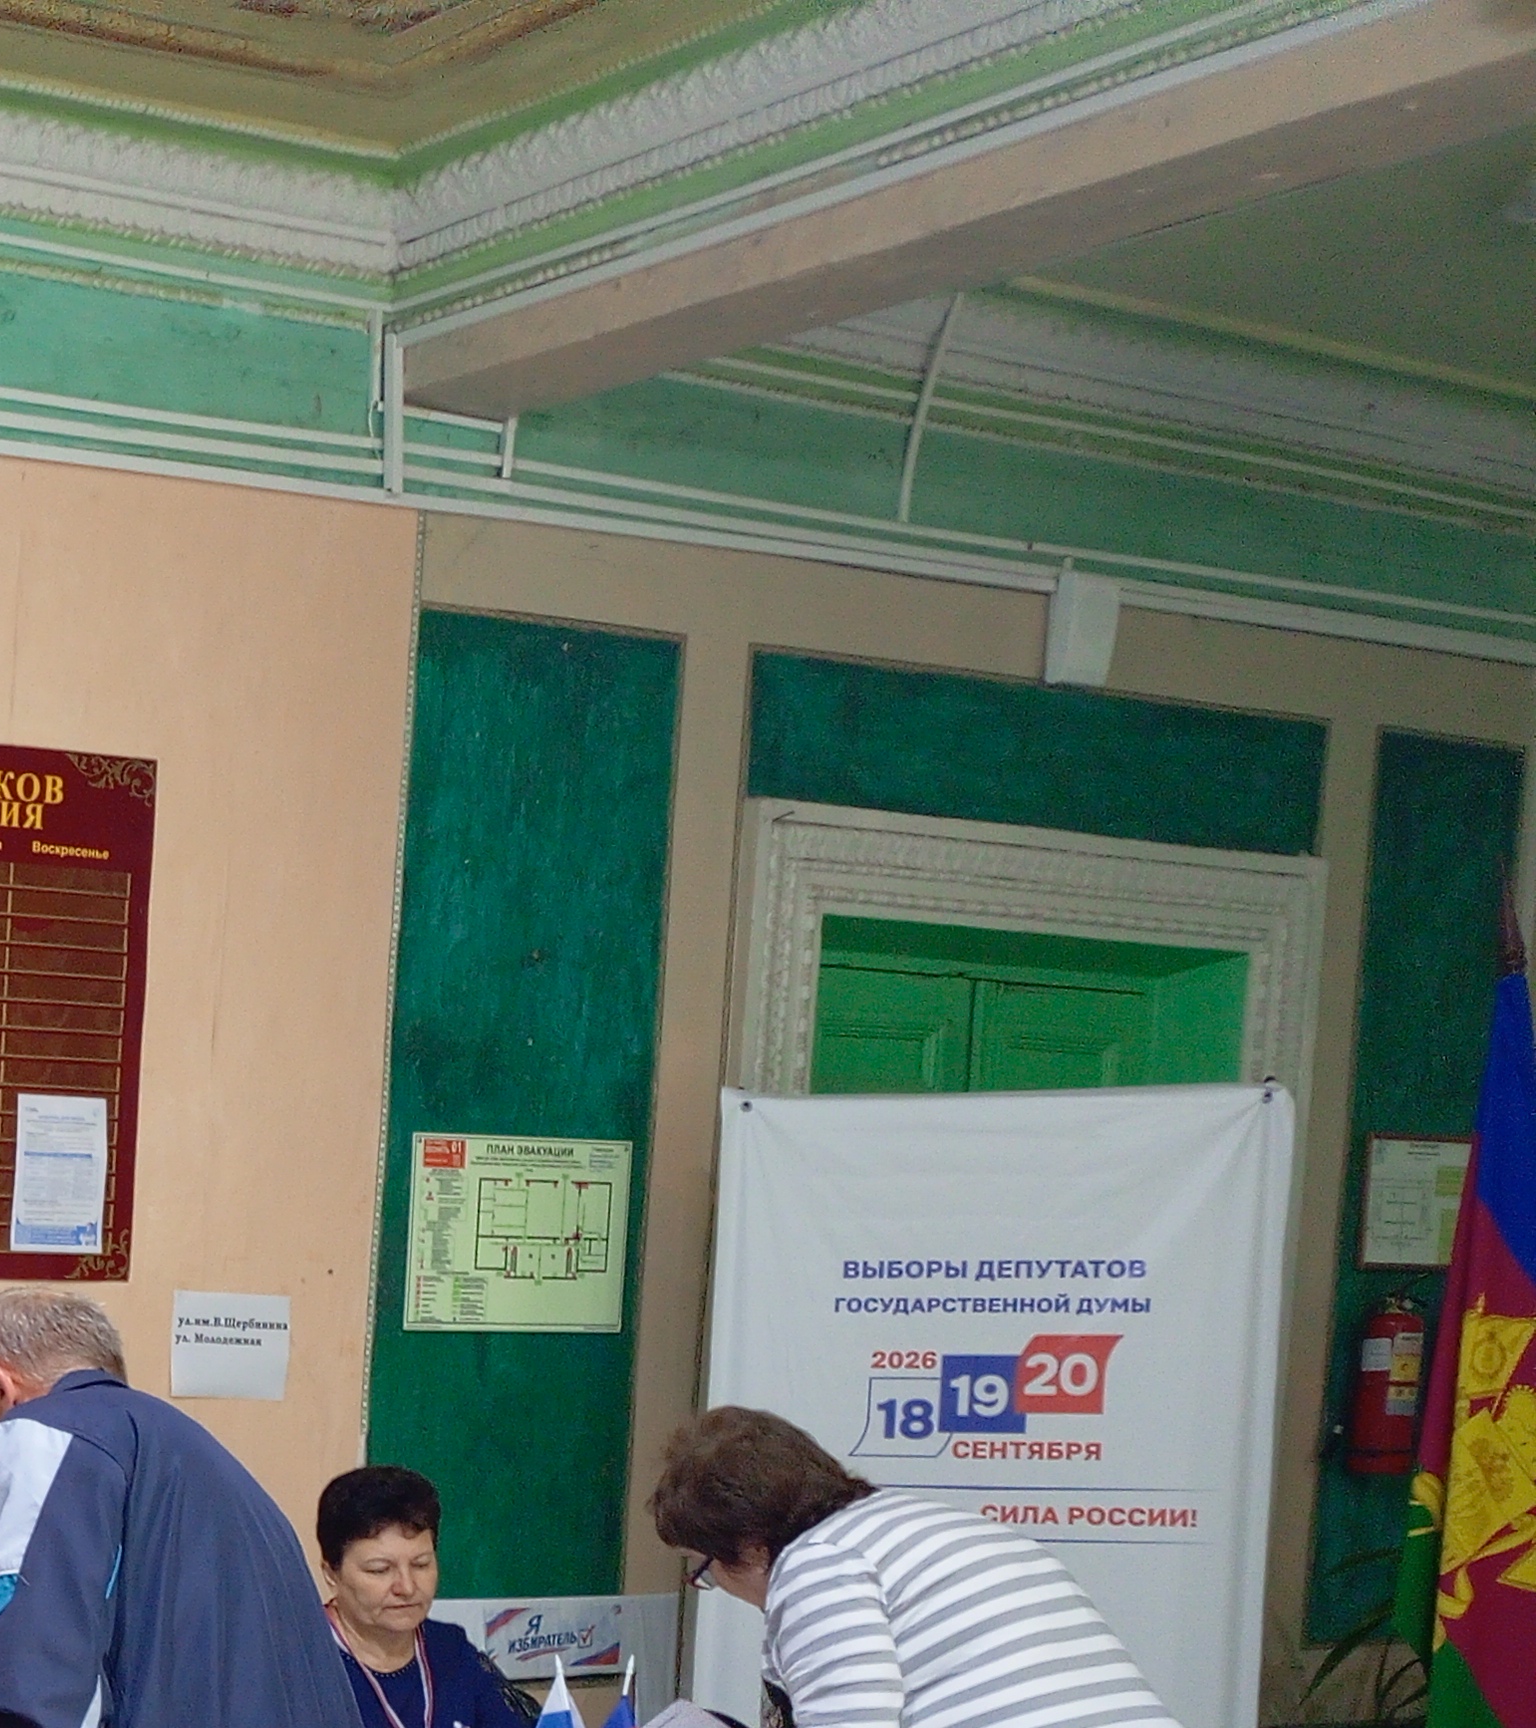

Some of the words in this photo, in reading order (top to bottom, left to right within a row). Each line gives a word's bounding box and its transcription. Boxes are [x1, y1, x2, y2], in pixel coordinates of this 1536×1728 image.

[32, 841, 109, 860] Воскресенье
[486, 1144, 514, 1154] ПЛАН
[517, 1145, 574, 1157] ЭВАКУАЦИИ
[842, 1259, 968, 1282] ВЫБОРЫ
[977, 1258, 1146, 1283] ДЕПУТАТОВ
[834, 1292, 1071, 1316] ГОСУДАРСТВЕННОЙ
[1078, 1296, 1151, 1316] ДУМЫ
[175, 1335, 190, 1345] ул.
[194, 1335, 262, 1347] Молодежная
[871, 1350, 937, 1370] 2026
[876, 1399, 934, 1439] 18
[950, 1375, 1009, 1417] 19
[1024, 1354, 1098, 1396] 20
[952, 1439, 1102, 1461] СЕНТЯБРЯ
[980, 1504, 1059, 1526] СИЛА
[1068, 1504, 1198, 1530] РОССИИ!
[526, 1614, 542, 1635] Я
[508, 1632, 577, 1653] ИЗБИРАТЕЛЬ
